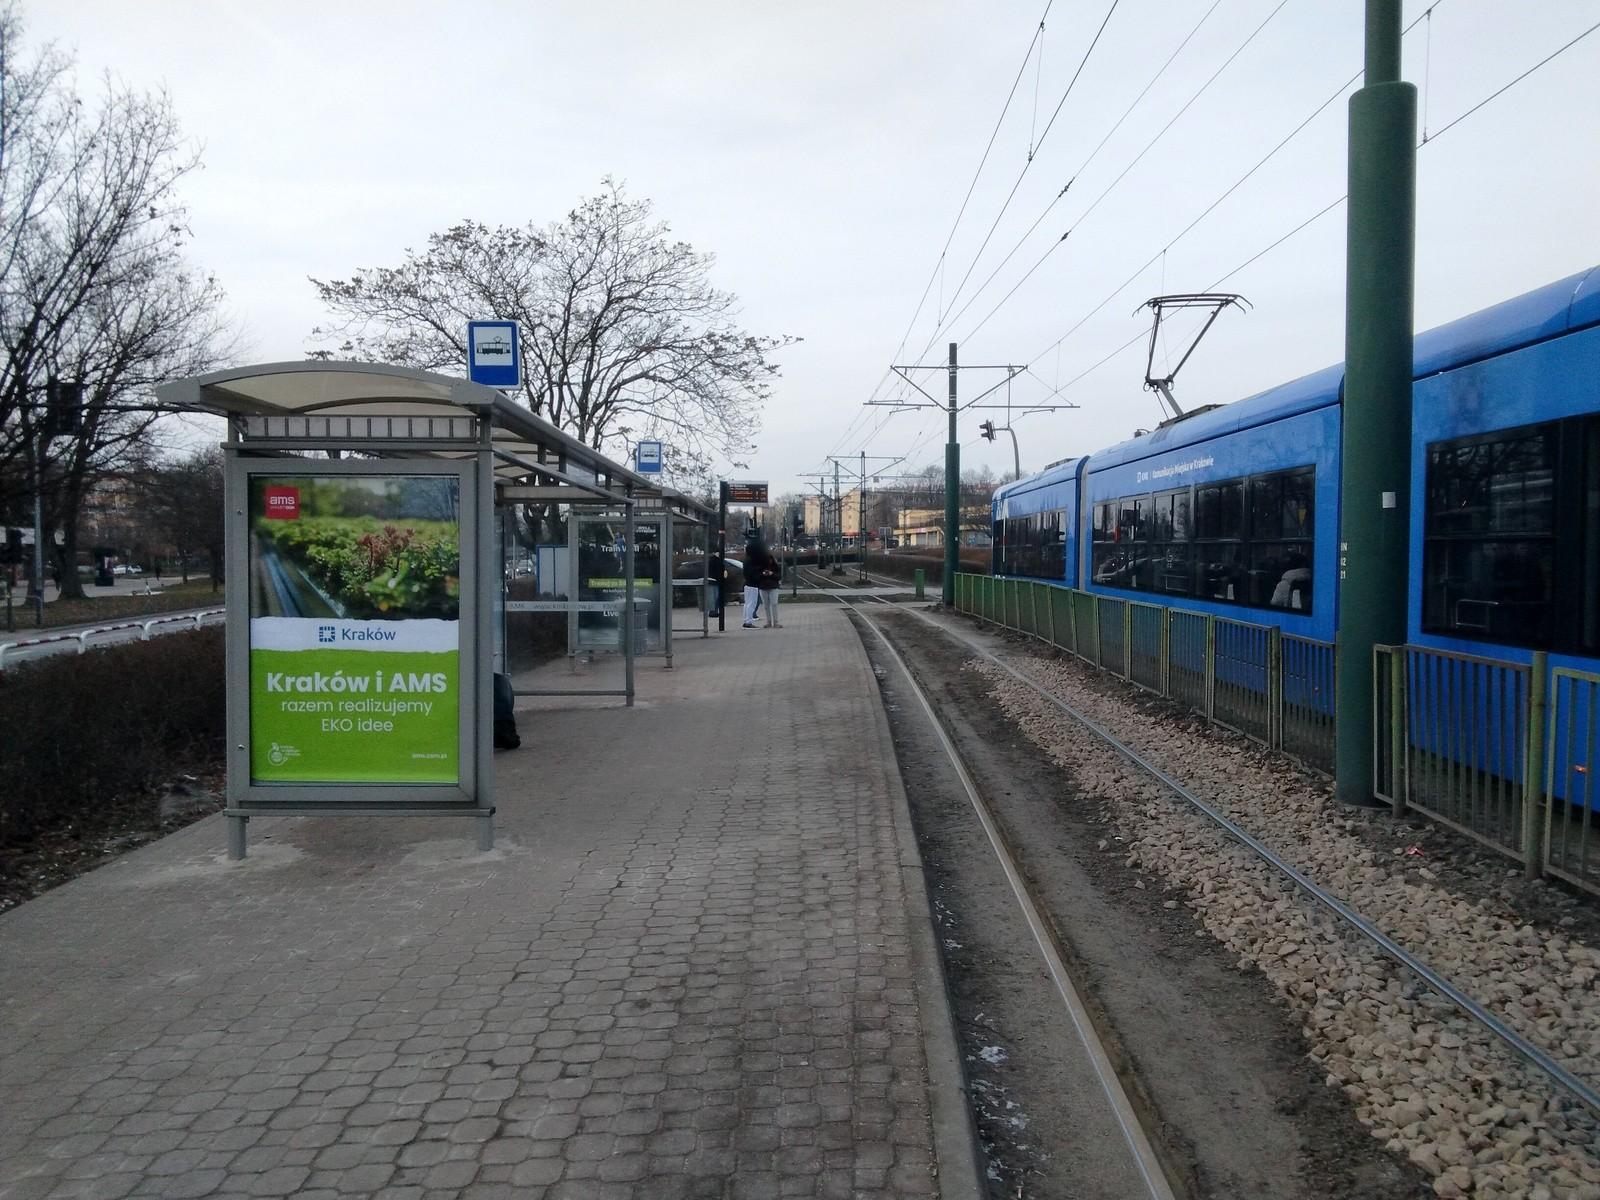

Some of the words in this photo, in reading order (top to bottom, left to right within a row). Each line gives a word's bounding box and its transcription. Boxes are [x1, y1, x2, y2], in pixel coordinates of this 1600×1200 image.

[269, 496, 295, 505] ams
[341, 626, 396, 641] Kraków
[267, 670, 369, 693] Kraków
[375, 671, 382, 693] i
[389, 672, 447, 693] AMS
[281, 701, 334, 713] razem
[338, 699, 433, 716] realizujemy
[321, 718, 353, 732] EKO
[357, 717, 394, 732] idee
